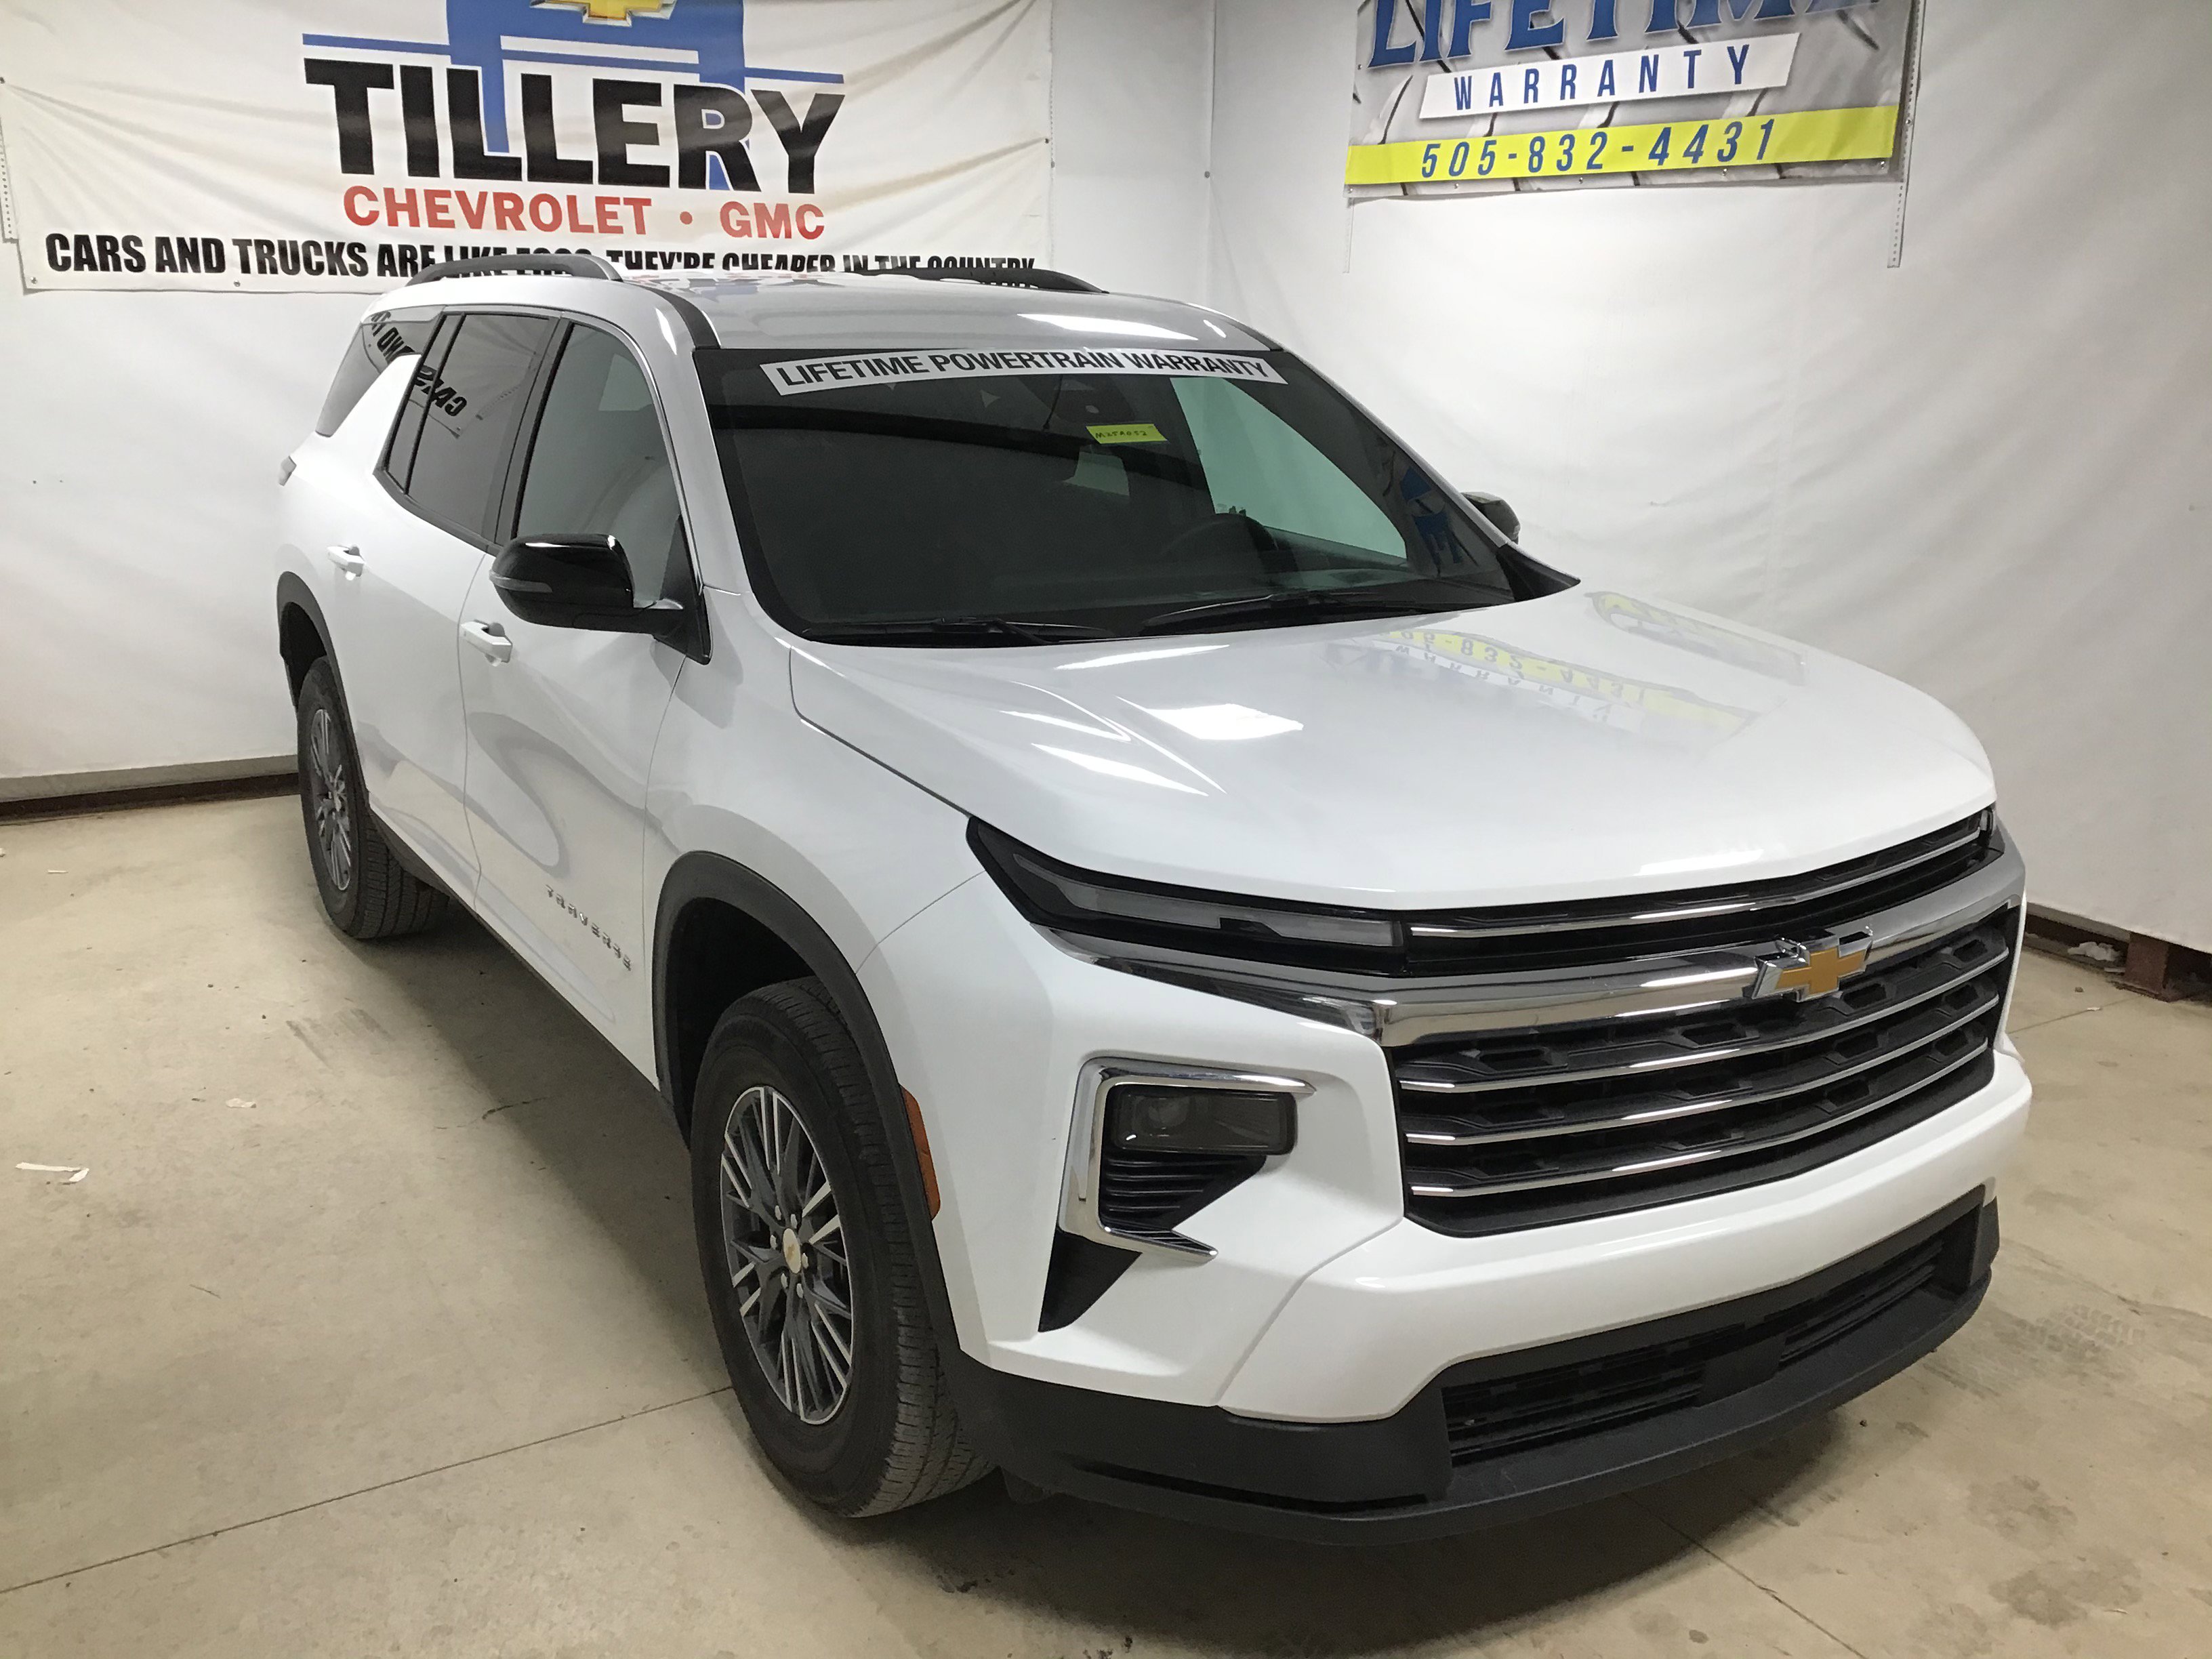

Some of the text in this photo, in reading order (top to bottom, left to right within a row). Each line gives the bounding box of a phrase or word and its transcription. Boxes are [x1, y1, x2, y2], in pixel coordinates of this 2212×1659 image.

[1367, 0, 1879, 68] LIFE
[1454, 44, 1751, 111] WARRANTY
[304, 58, 845, 194] TILLERY
[1421, 118, 1776, 179] 505-832-4431
[344, 185, 825, 240] CHEVROLET GMC
[45, 232, 146, 273] CARS
[155, 237, 226, 274] AND
[232, 237, 369, 277] TRUCKS
[377, 244, 434, 277] ARE
[776, 351, 1269, 386] LIFETIME POWERTRAIN WARRANTY
[546, 884, 632, 972] TRAVERSE
